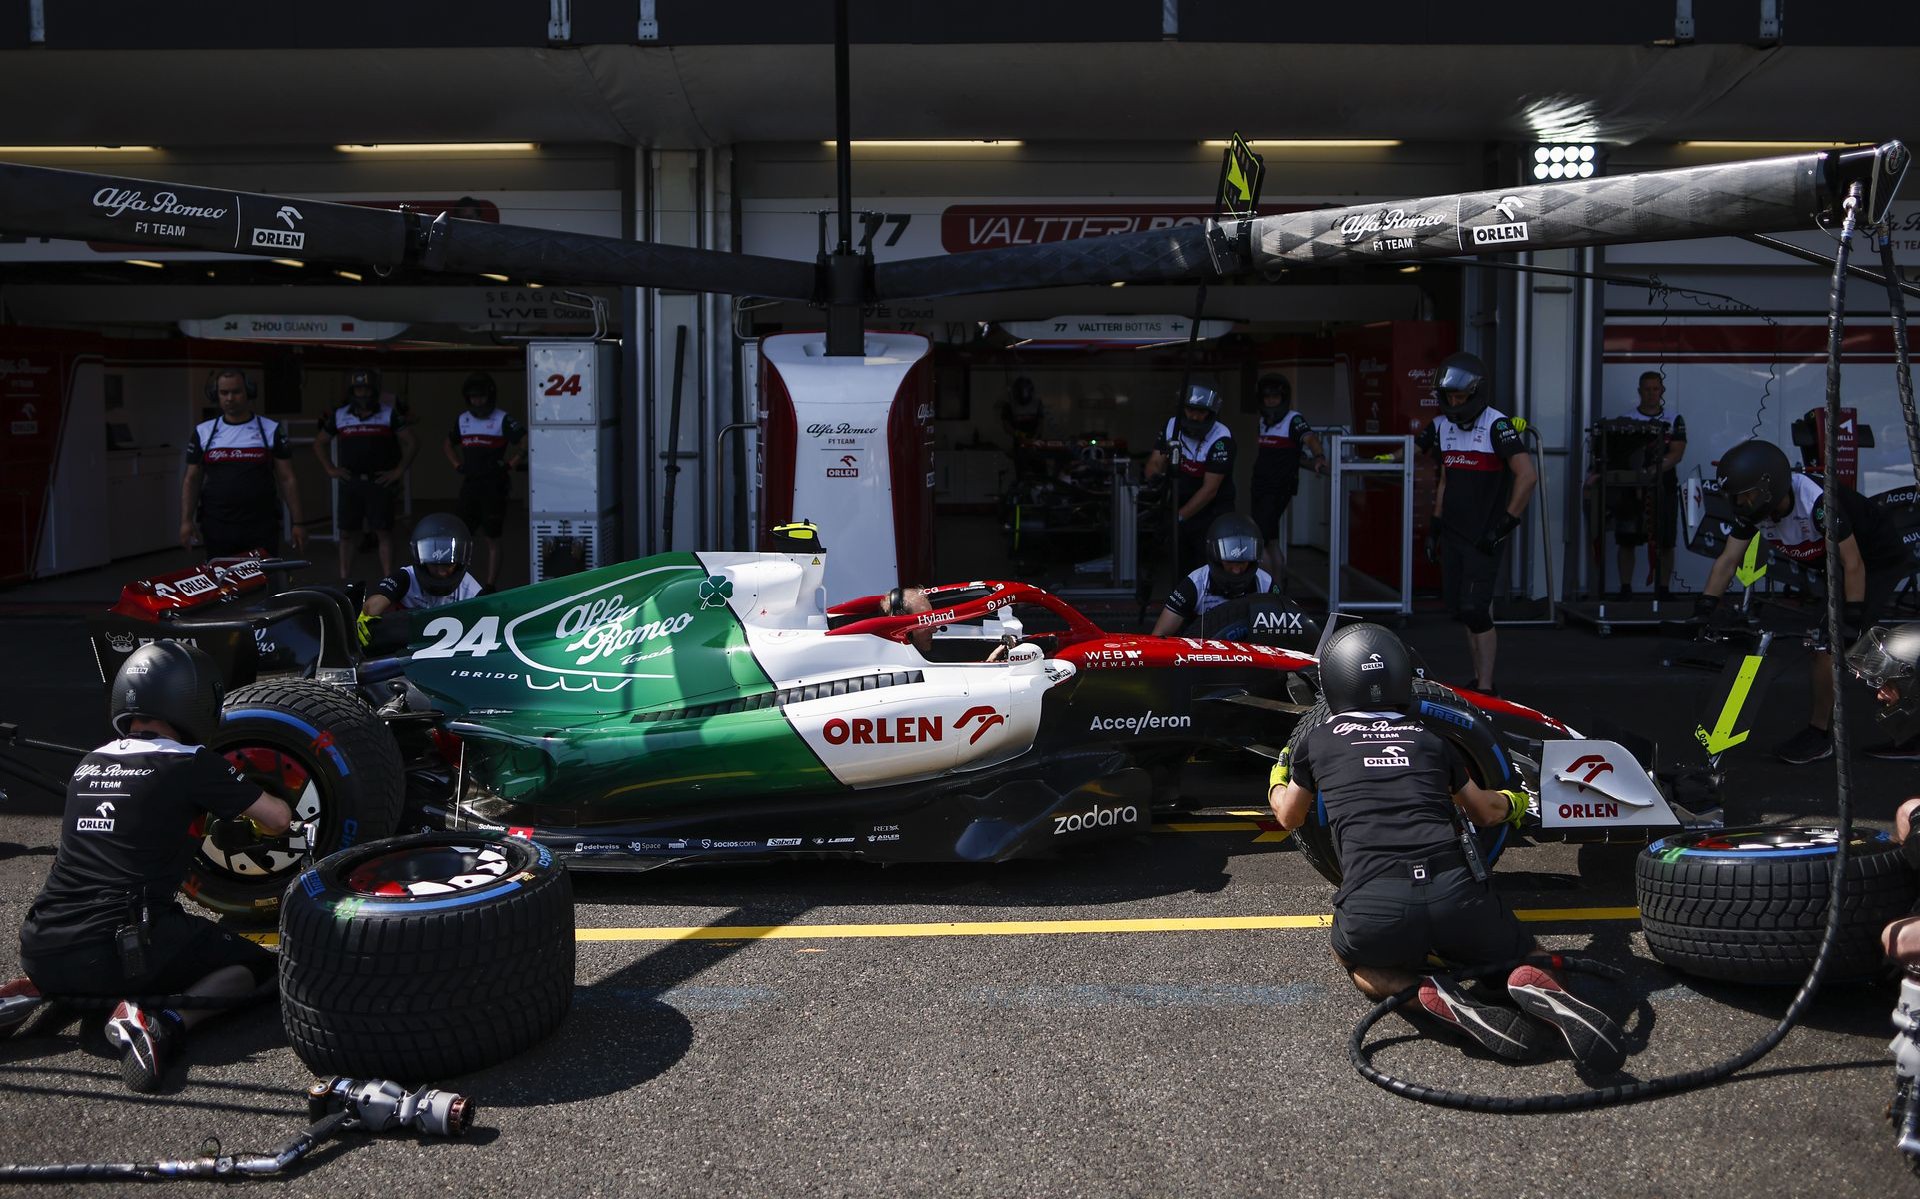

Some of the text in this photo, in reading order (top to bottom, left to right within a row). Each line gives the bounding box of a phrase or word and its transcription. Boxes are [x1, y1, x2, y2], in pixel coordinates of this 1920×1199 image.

[93, 187, 228, 219] Alfa Romeo
[135, 222, 186, 237] F1 TEAM
[1341, 209, 1447, 242] Alfa Romeo
[1476, 225, 1526, 242] ORLEN
[255, 231, 302, 247] ORLEN
[1373, 238, 1413, 251] F1 TEAM
[488, 309, 548, 318] LYVE
[252, 322, 282, 331] ZHOU
[1054, 322, 1161, 331] 77 VALTTERI BOTTAS
[545, 374, 582, 396] 24
[807, 422, 877, 438] Alfa Romeo
[179, 577, 213, 594] ORLEN
[997, 595, 1016, 607] PATH
[556, 594, 640, 639] Alfa
[917, 610, 955, 626] Hyland
[1252, 612, 1303, 628] AMX
[411, 616, 502, 660] 24
[564, 612, 694, 666] Romeo
[1085, 650, 1125, 660] WEB
[1187, 654, 1253, 662] REBELLION
[1363, 662, 1383, 670] ORLEN
[451, 671, 519, 680] IBRIDO
[1421, 701, 1472, 729] PIRELLI
[823, 716, 943, 745] ORLEN
[1332, 720, 1424, 736] Alfa Romeo
[1366, 757, 1407, 766] ORLEN
[73, 763, 155, 780] Alfa Romeo
[1559, 803, 1618, 818] ORLEN
[79, 819, 111, 830] ORLEN
[1053, 804, 1137, 835] zadara
[583, 843, 620, 851] edelweiss
[713, 840, 757, 848] socios.com
